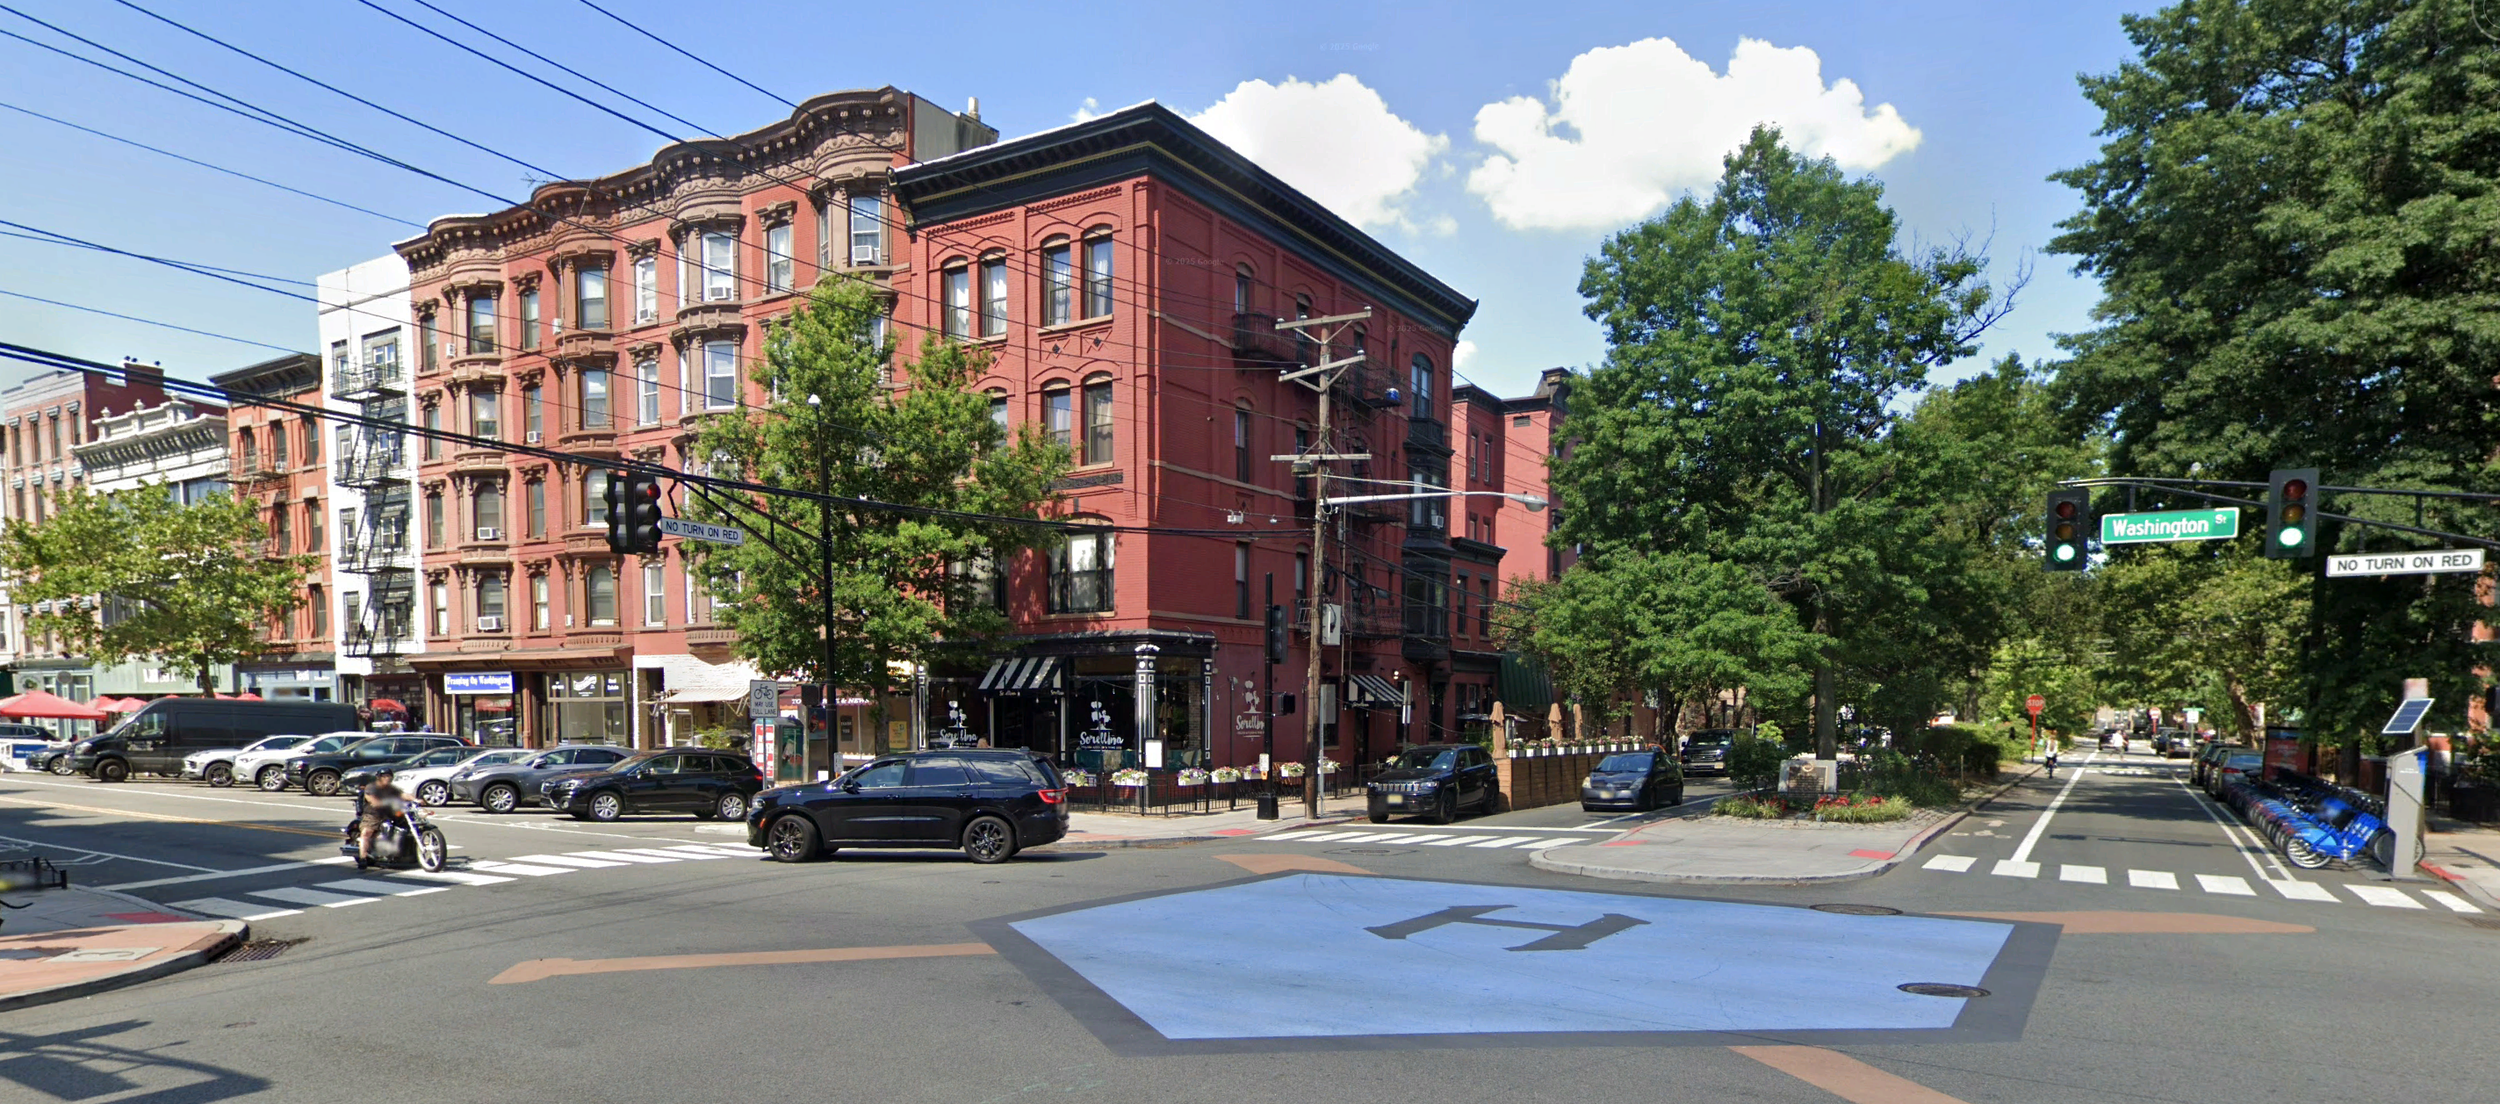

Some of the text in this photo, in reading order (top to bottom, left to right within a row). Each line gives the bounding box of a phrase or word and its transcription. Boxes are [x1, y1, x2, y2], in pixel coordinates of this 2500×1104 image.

[666, 521, 739, 540] NO TURN ON RED
[2112, 514, 2227, 538] Washington St
[2337, 554, 2473, 571] NO TURN ON RED
[1235, 714, 1265, 730] Sorellin
